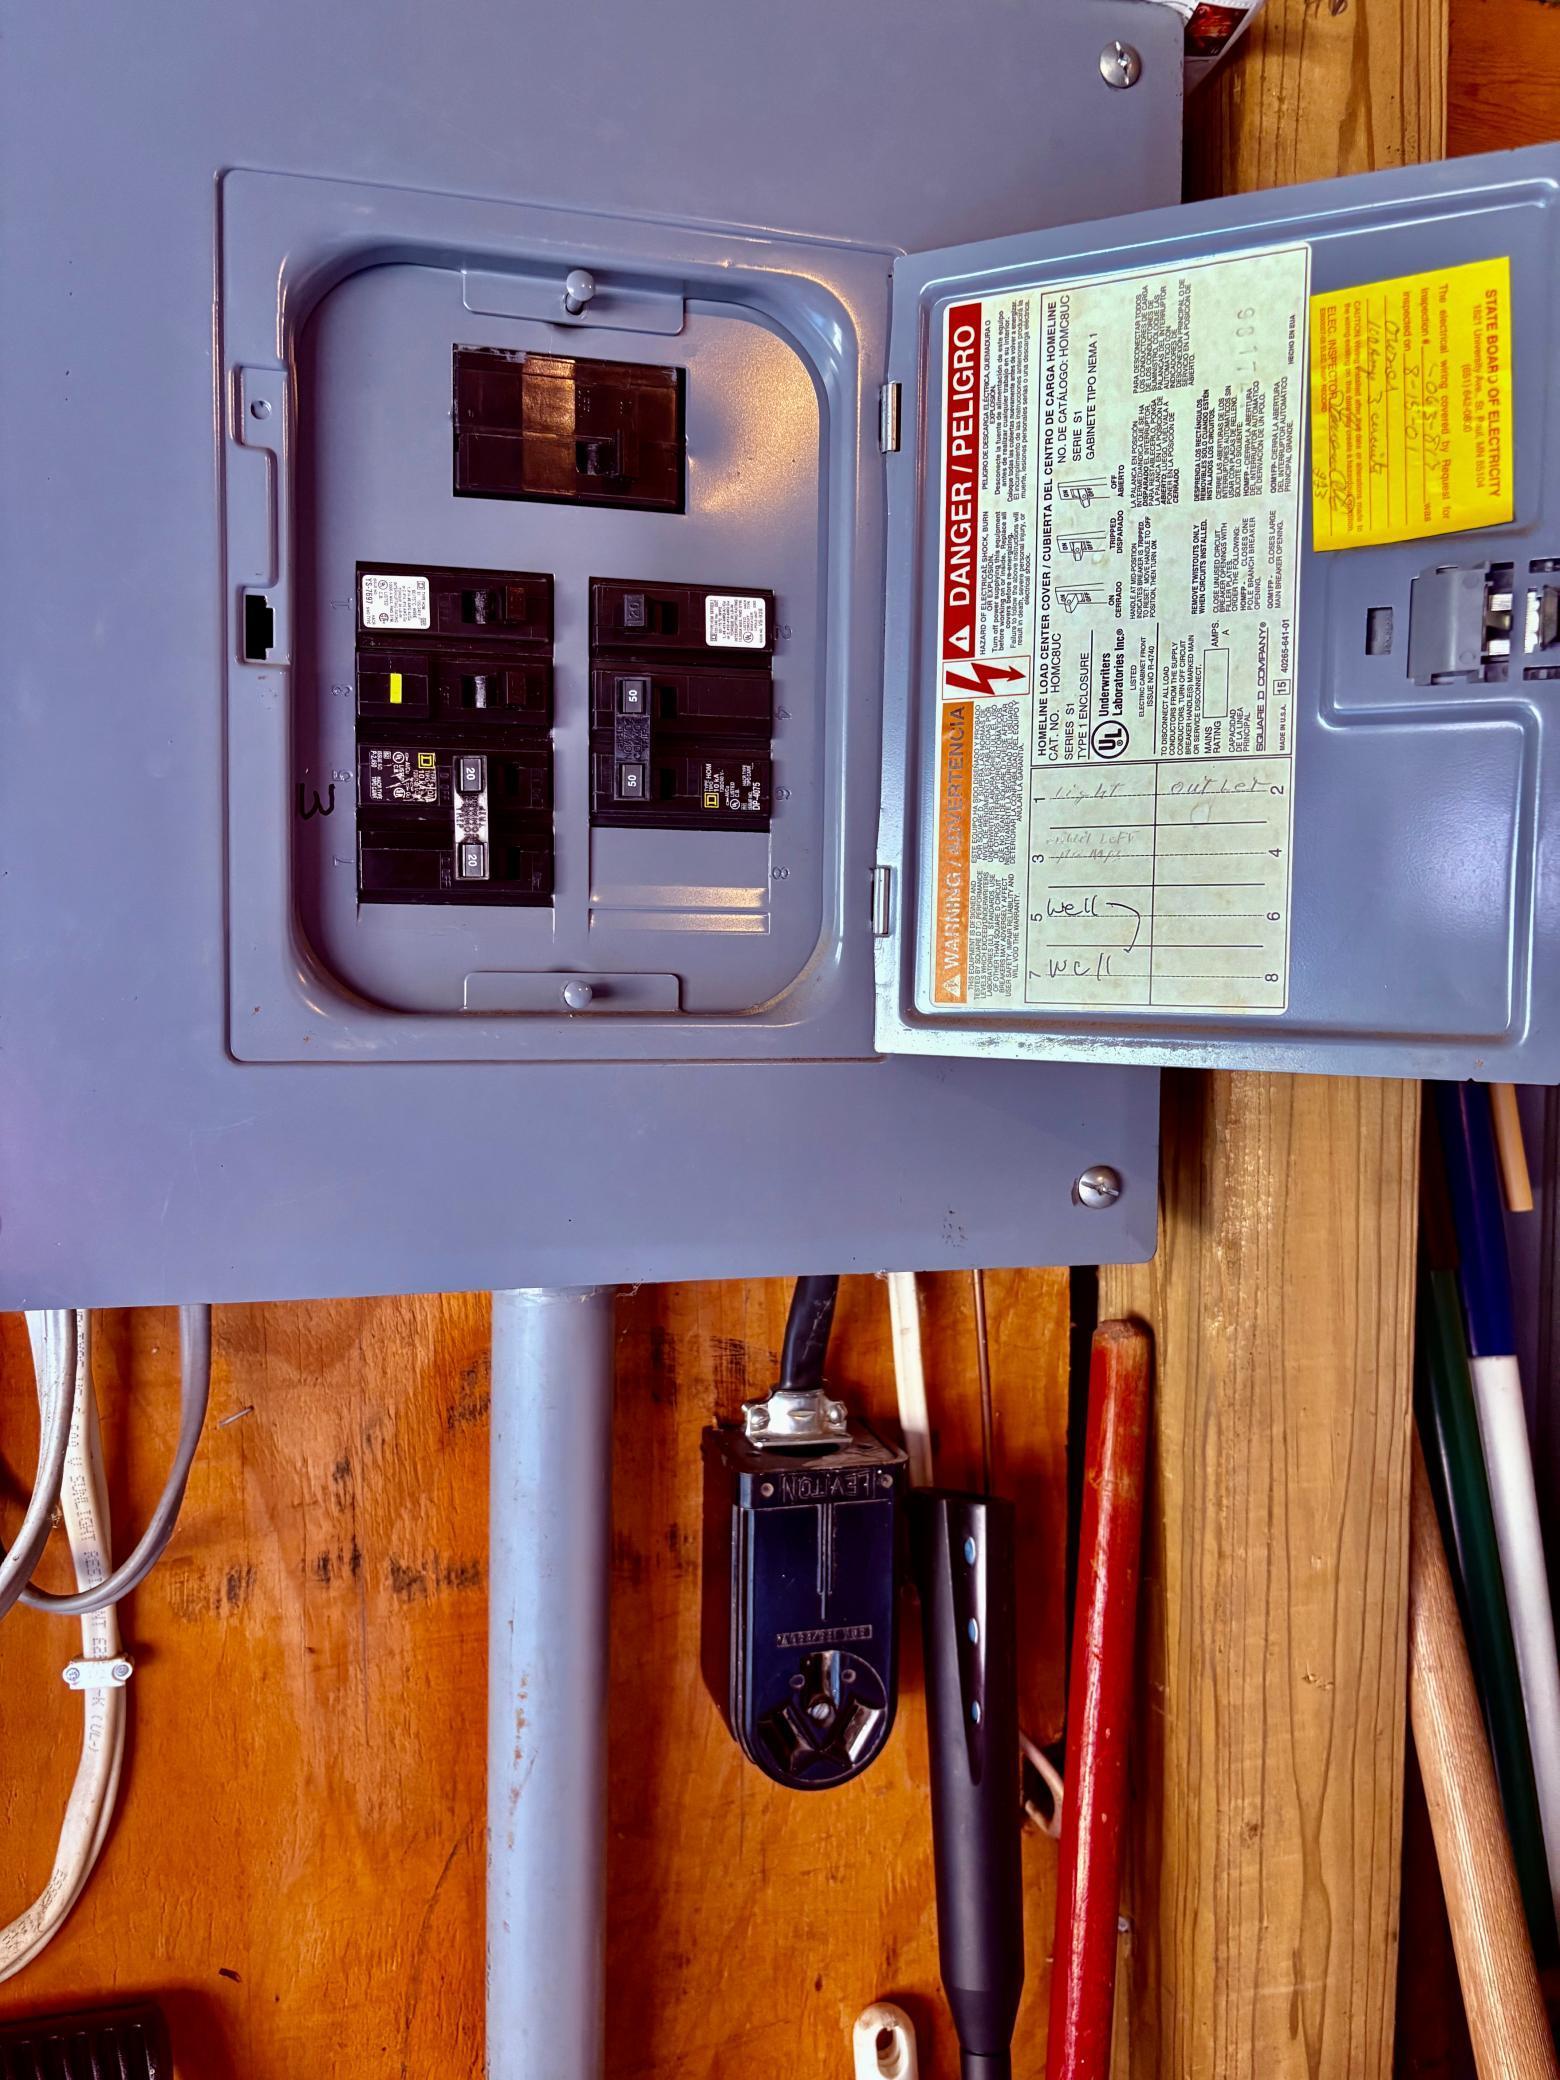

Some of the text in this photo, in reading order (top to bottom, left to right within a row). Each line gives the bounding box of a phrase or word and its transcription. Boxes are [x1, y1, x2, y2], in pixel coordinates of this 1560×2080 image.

[1420, 288, 1430, 336] Inspection
[1046, 302, 1057, 362] HOMELINE
[1404, 339, 1411, 351] on
[1088, 341, 1098, 374] NEMA
[1472, 330, 1483, 373] University
[1045, 365, 1055, 406] CARGA
[1087, 376, 1097, 400] TIPO
[1486, 290, 1500, 497] STATE BOARD OF ELECTRICITY
[1439, 284, 1451, 519] The electrical wiring covered by Request for
[1044, 410, 1054, 425] DE
[1057, 426, 1067, 442] DE
[1072, 410, 1082, 462] SERIE S1
[1086, 405, 1096, 460] GABINETE
[1043, 429, 1054, 476] CENTRO
[1057, 445, 1067, 463] NO.
[1476, 442, 1484, 457] MN
[949, 325, 975, 606] DANGER / PELIGRO
[1043, 479, 1053, 501] DEL
[1424, 503, 1432, 522] was
[1041, 505, 1052, 562] CUBIERTA
[1192, 525, 1200, 544] ONLY
[1191, 545, 1199, 584] TWISTOUTS
[1199, 561, 1207, 592] CIRCUITS
[1040, 572, 1051, 611] COVER
[1108, 594, 1114, 606] ON
[1198, 594, 1206, 614] WHEN
[1039, 615, 1050, 660] CENTER
[1281, 619, 1289, 673] 40265-641-01
[1038, 664, 1049, 695] LOAD
[1078, 652, 1089, 720] ENCLOSURE
[1098, 653, 1110, 716] Underwriters
[1112, 653, 1124, 716] Laboratories
[1147, 672, 1154, 684] NO
[1277, 682, 1286, 694] 15
[628, 689, 638, 702] 50
[1049, 632, 1061, 761] CAT. NO. HOMC8UC
[1138, 687, 1146, 717] ELECTRIC
[1146, 685, 1154, 706] ISSUE
[1258, 690, 1264, 700] D
[1037, 698, 1048, 755] HOMELINE
[1065, 702, 1074, 760] SERIES S1
[1169, 707, 1177, 755] CONDUCTORS
[1213, 720, 1221, 753] RATING
[1236, 731, 1243, 740] LA
[1256, 705, 1264, 751] SQUARE
[1077, 732, 1087, 759] TYPE
[1161, 746, 1168, 756] TO
[1194, 744, 1200, 754] OR
[1236, 742, 1243, 752] DE
[466, 768, 476, 780] 20
[627, 774, 637, 788] 50
[946, 706, 964, 854] ADVERTENCIA
[713, 784, 719, 792] 10
[752, 782, 760, 810] DP-4075
[1271, 785, 1283, 795] 2
[468, 854, 478, 866] 20
[1032, 854, 1044, 864] 3
[1268, 848, 1280, 857] 4
[943, 872, 960, 970] WARNING
[1031, 913, 1042, 922] 5
[1267, 911, 1279, 921] 6
[1029, 971, 1041, 979] 7
[1265, 973, 1278, 982] 8
